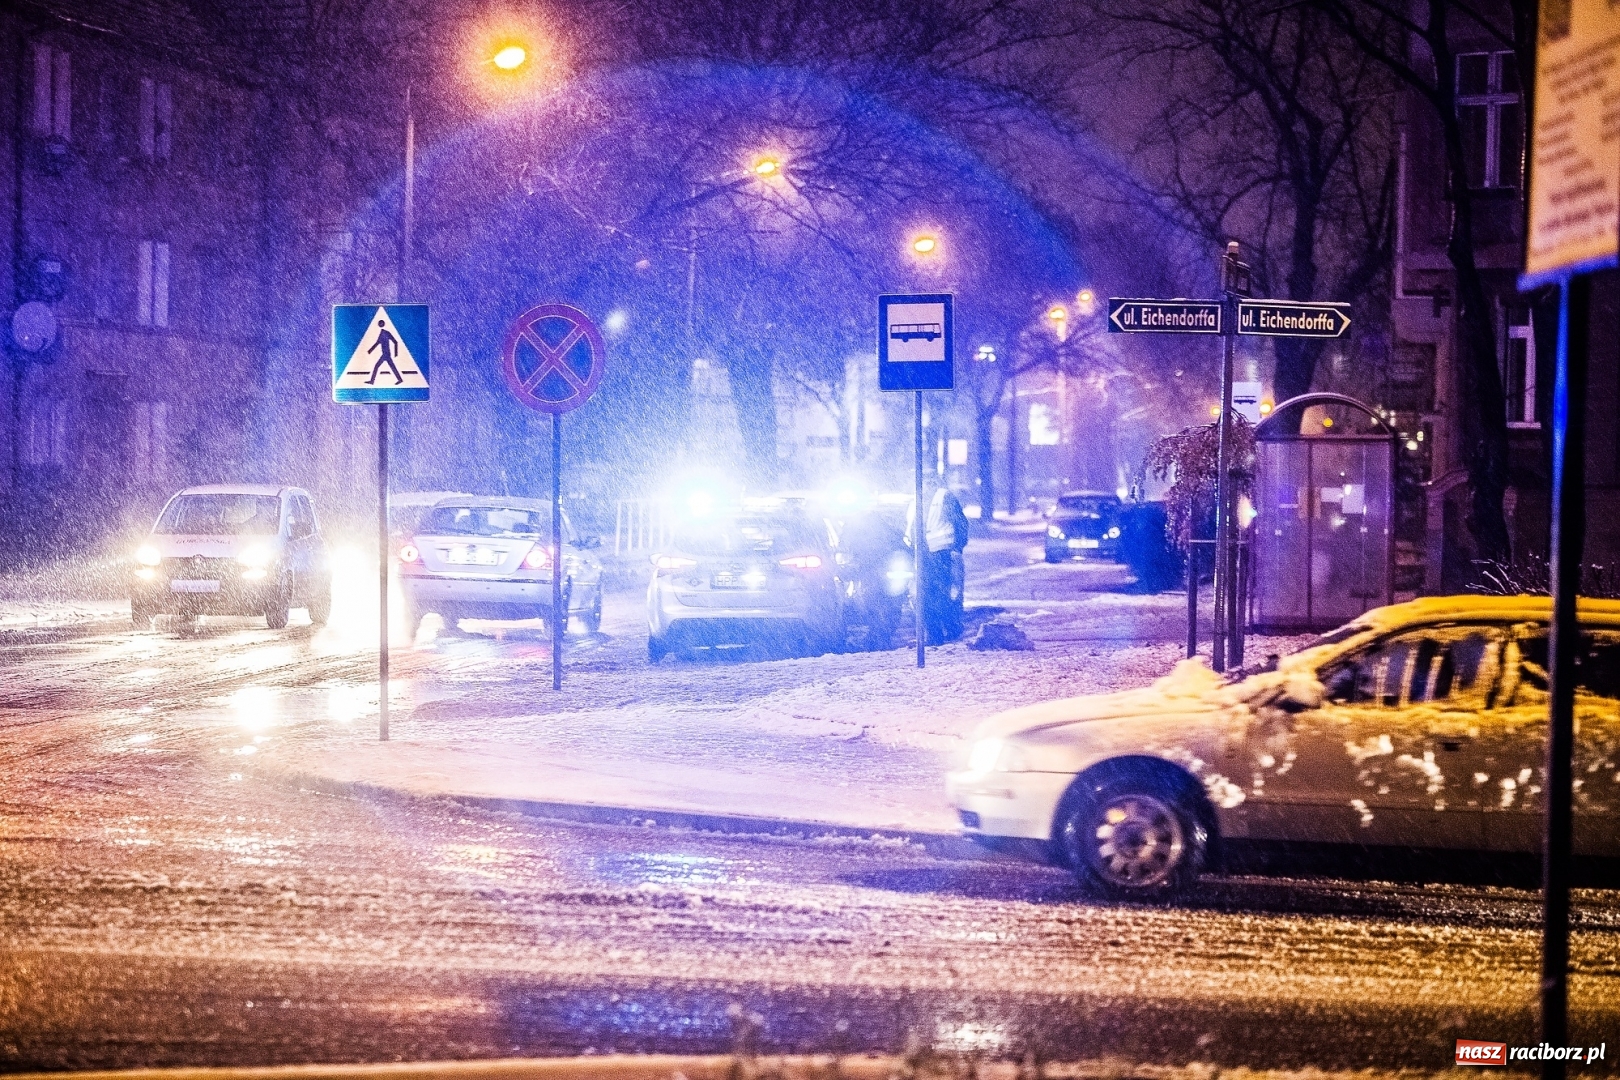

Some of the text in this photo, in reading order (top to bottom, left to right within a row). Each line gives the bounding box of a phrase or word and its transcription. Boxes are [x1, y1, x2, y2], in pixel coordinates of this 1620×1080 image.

[1123, 308, 1216, 327] ul. Eichendorffa
[1242, 309, 1335, 331] ul. Eichendorffa
